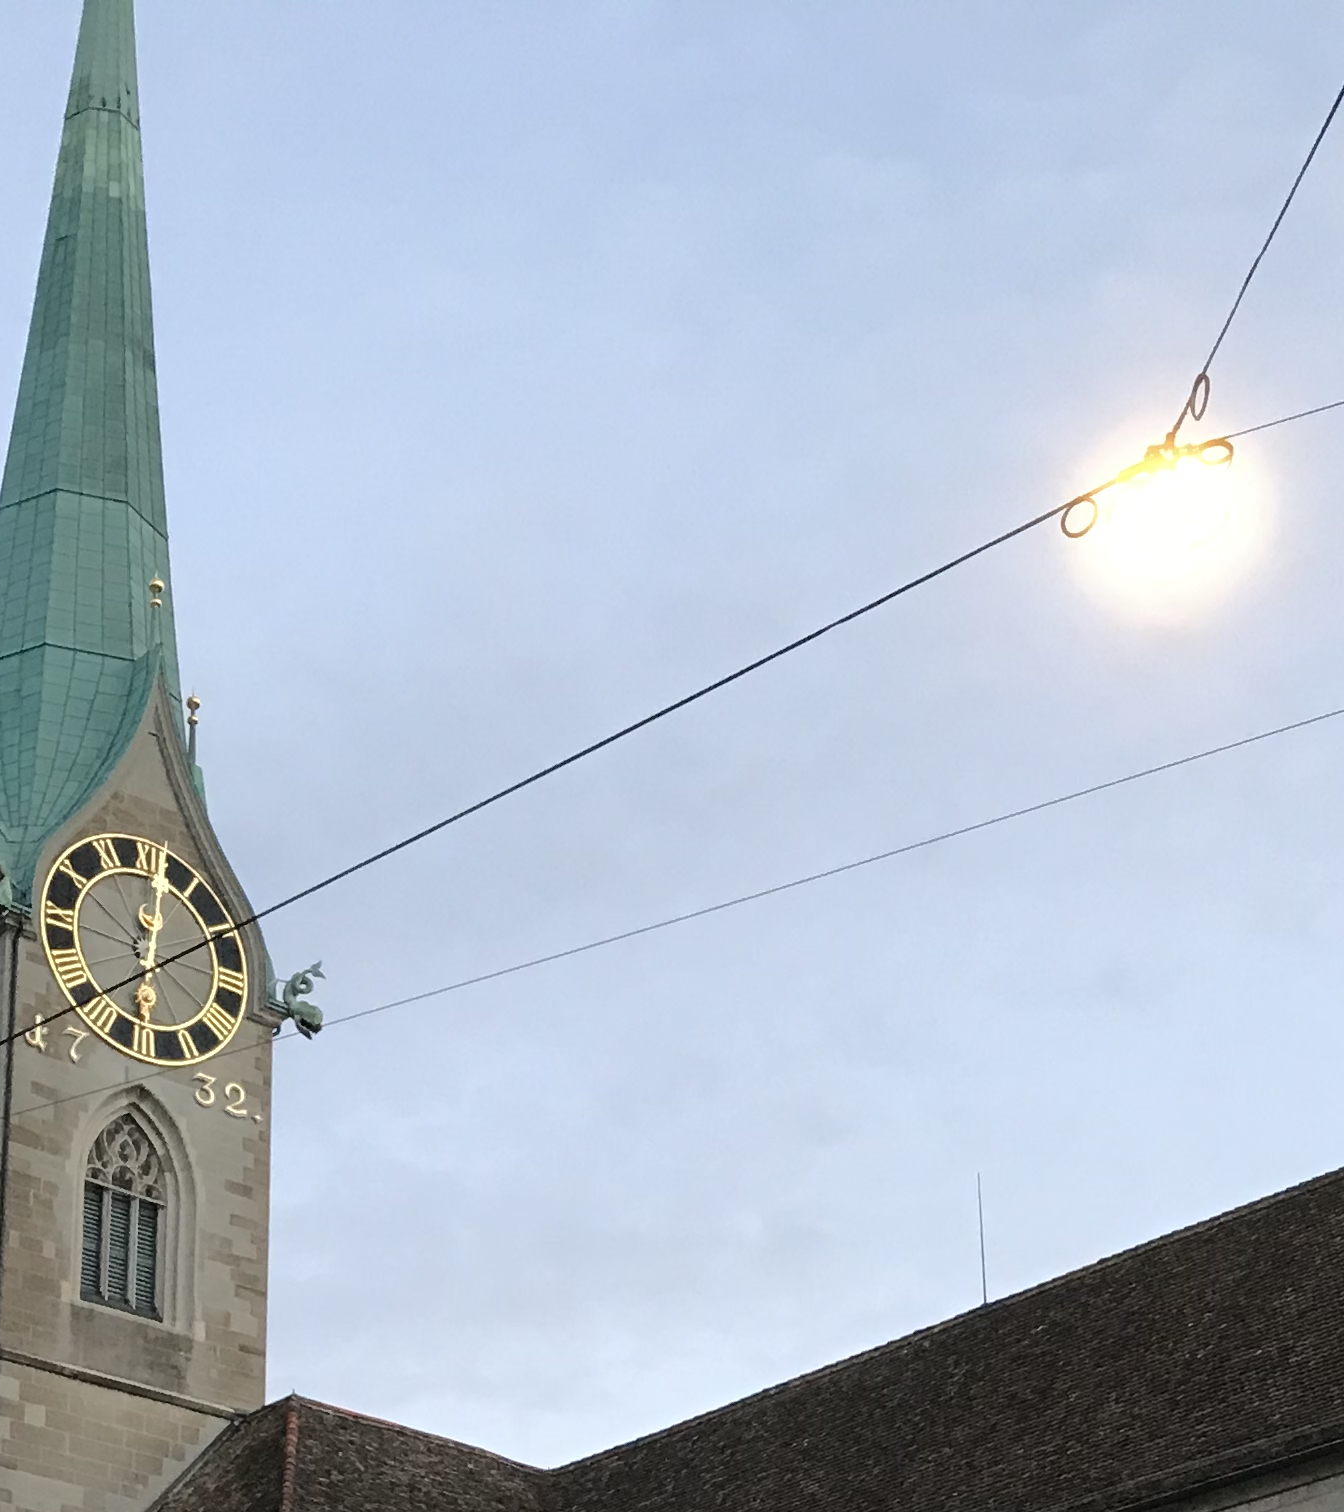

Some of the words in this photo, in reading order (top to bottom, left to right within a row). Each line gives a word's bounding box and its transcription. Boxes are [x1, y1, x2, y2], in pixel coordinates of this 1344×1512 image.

[92, 839, 121, 869] XI
[59, 858, 87, 889] X
[184, 876, 200, 897] I
[46, 900, 73, 931] IX
[51, 948, 88, 989] VIII
[218, 967, 244, 995] III
[202, 1002, 236, 1041] IIII
[132, 1023, 156, 1058] VI
[178, 1030, 199, 1058] V
